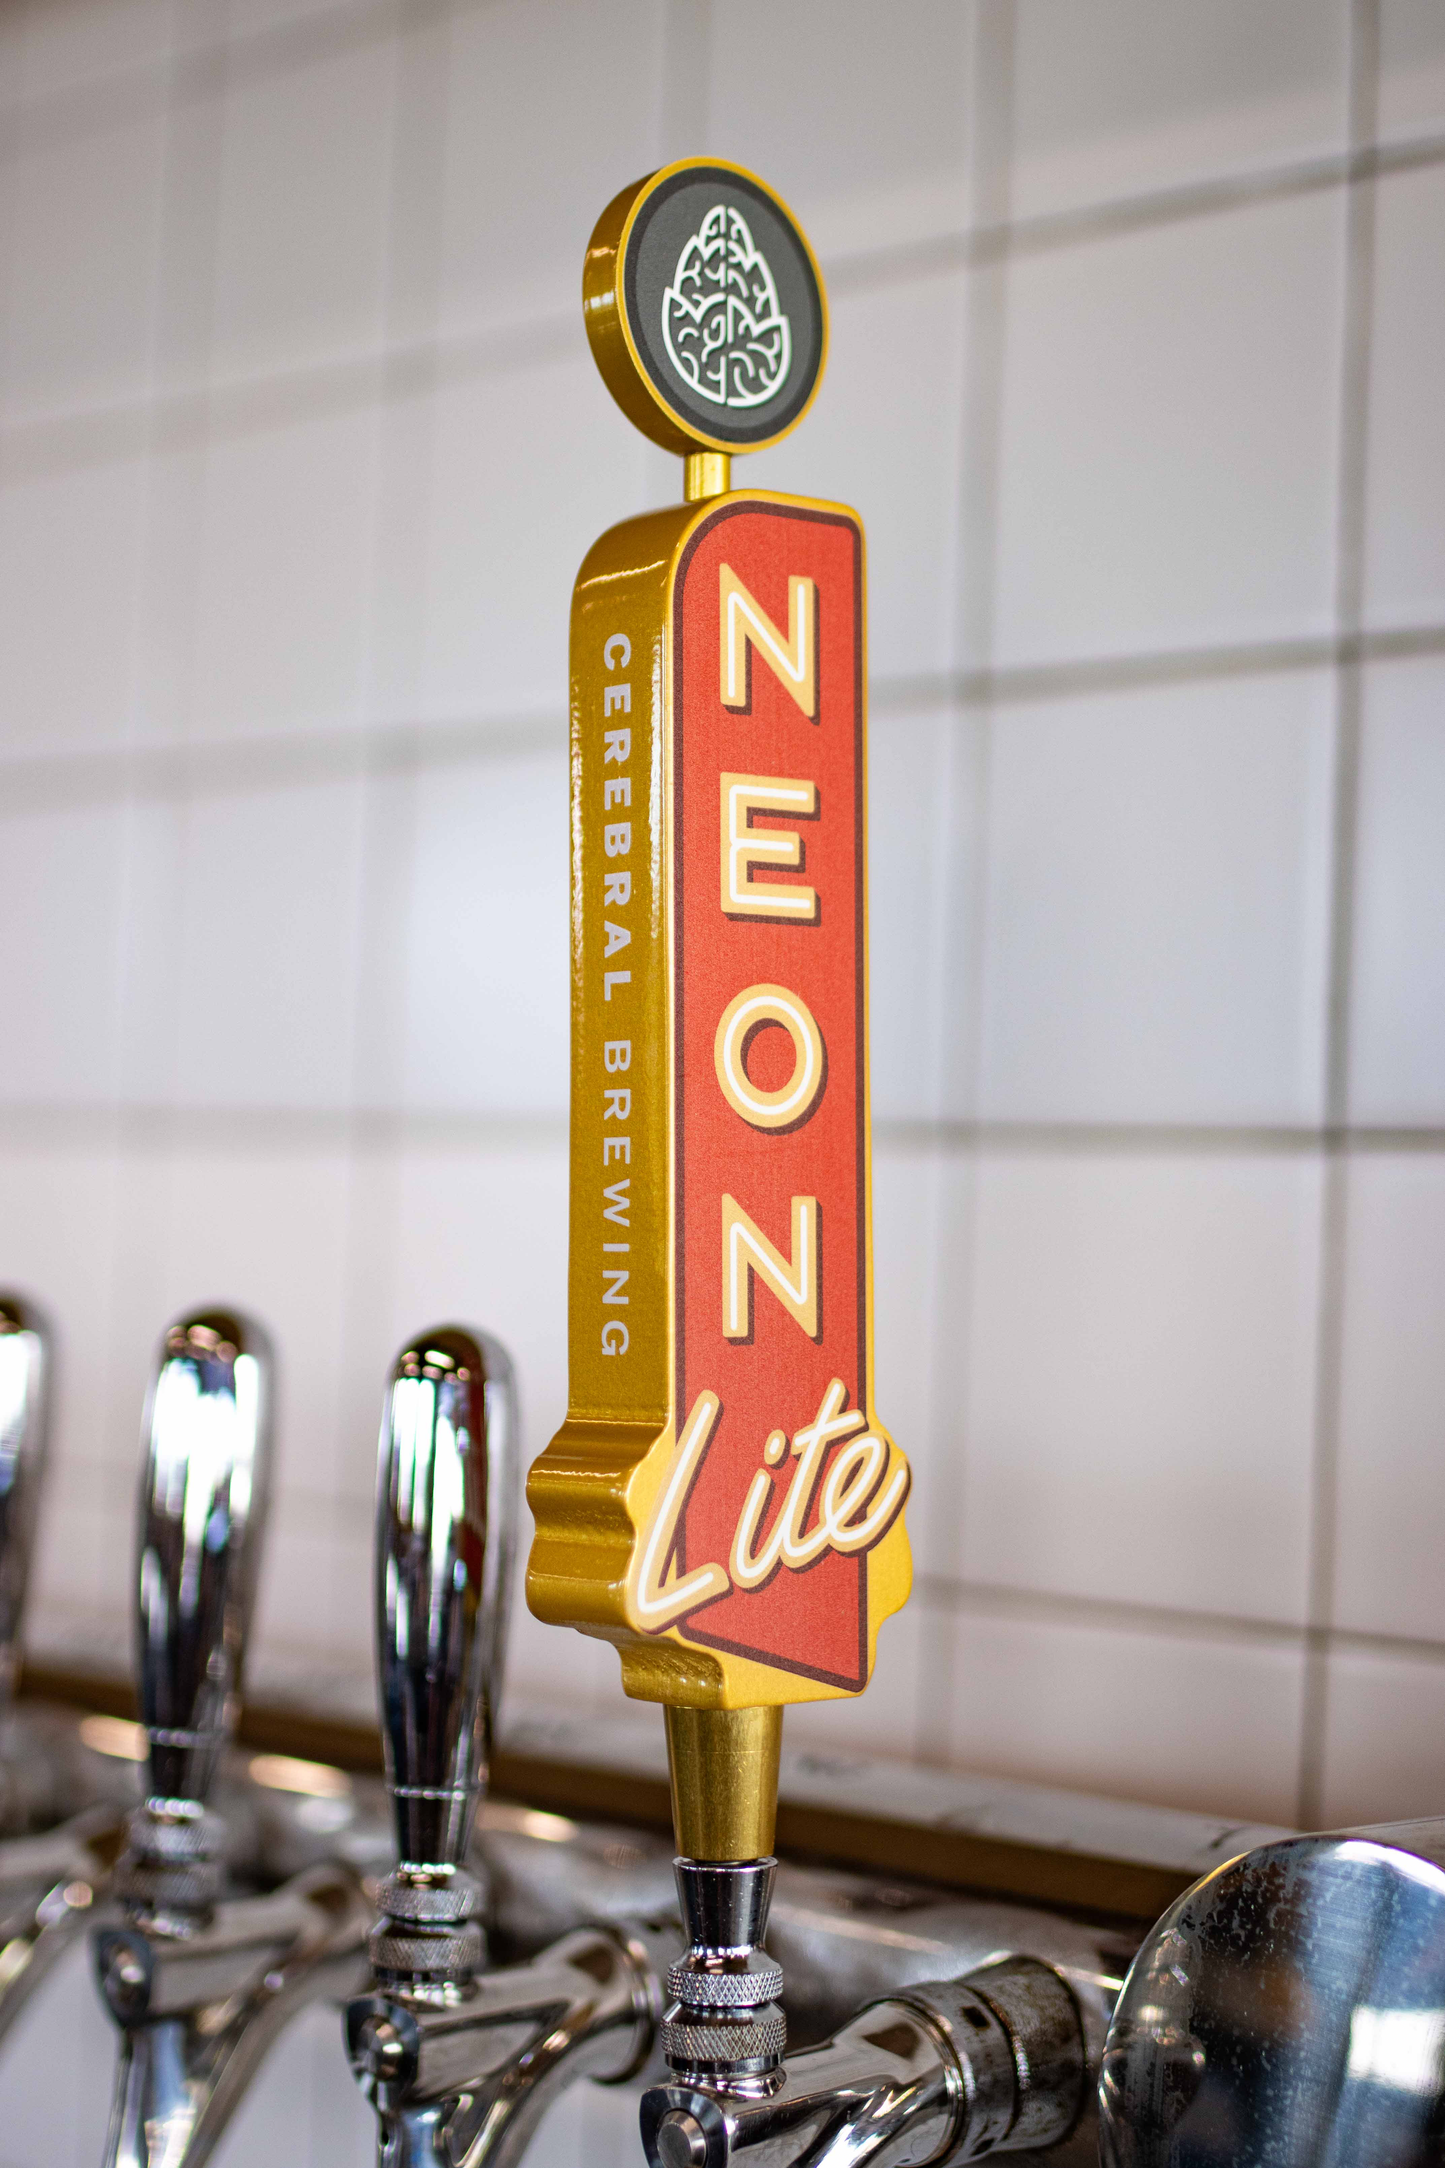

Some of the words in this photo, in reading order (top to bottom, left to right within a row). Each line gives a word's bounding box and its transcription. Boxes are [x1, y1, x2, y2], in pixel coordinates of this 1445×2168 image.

[603, 632, 632, 1001] CEREBRAL
[714, 562, 826, 1344] NEON
[601, 1039, 632, 1357] BREWING
[627, 1378, 911, 1633] Lite
